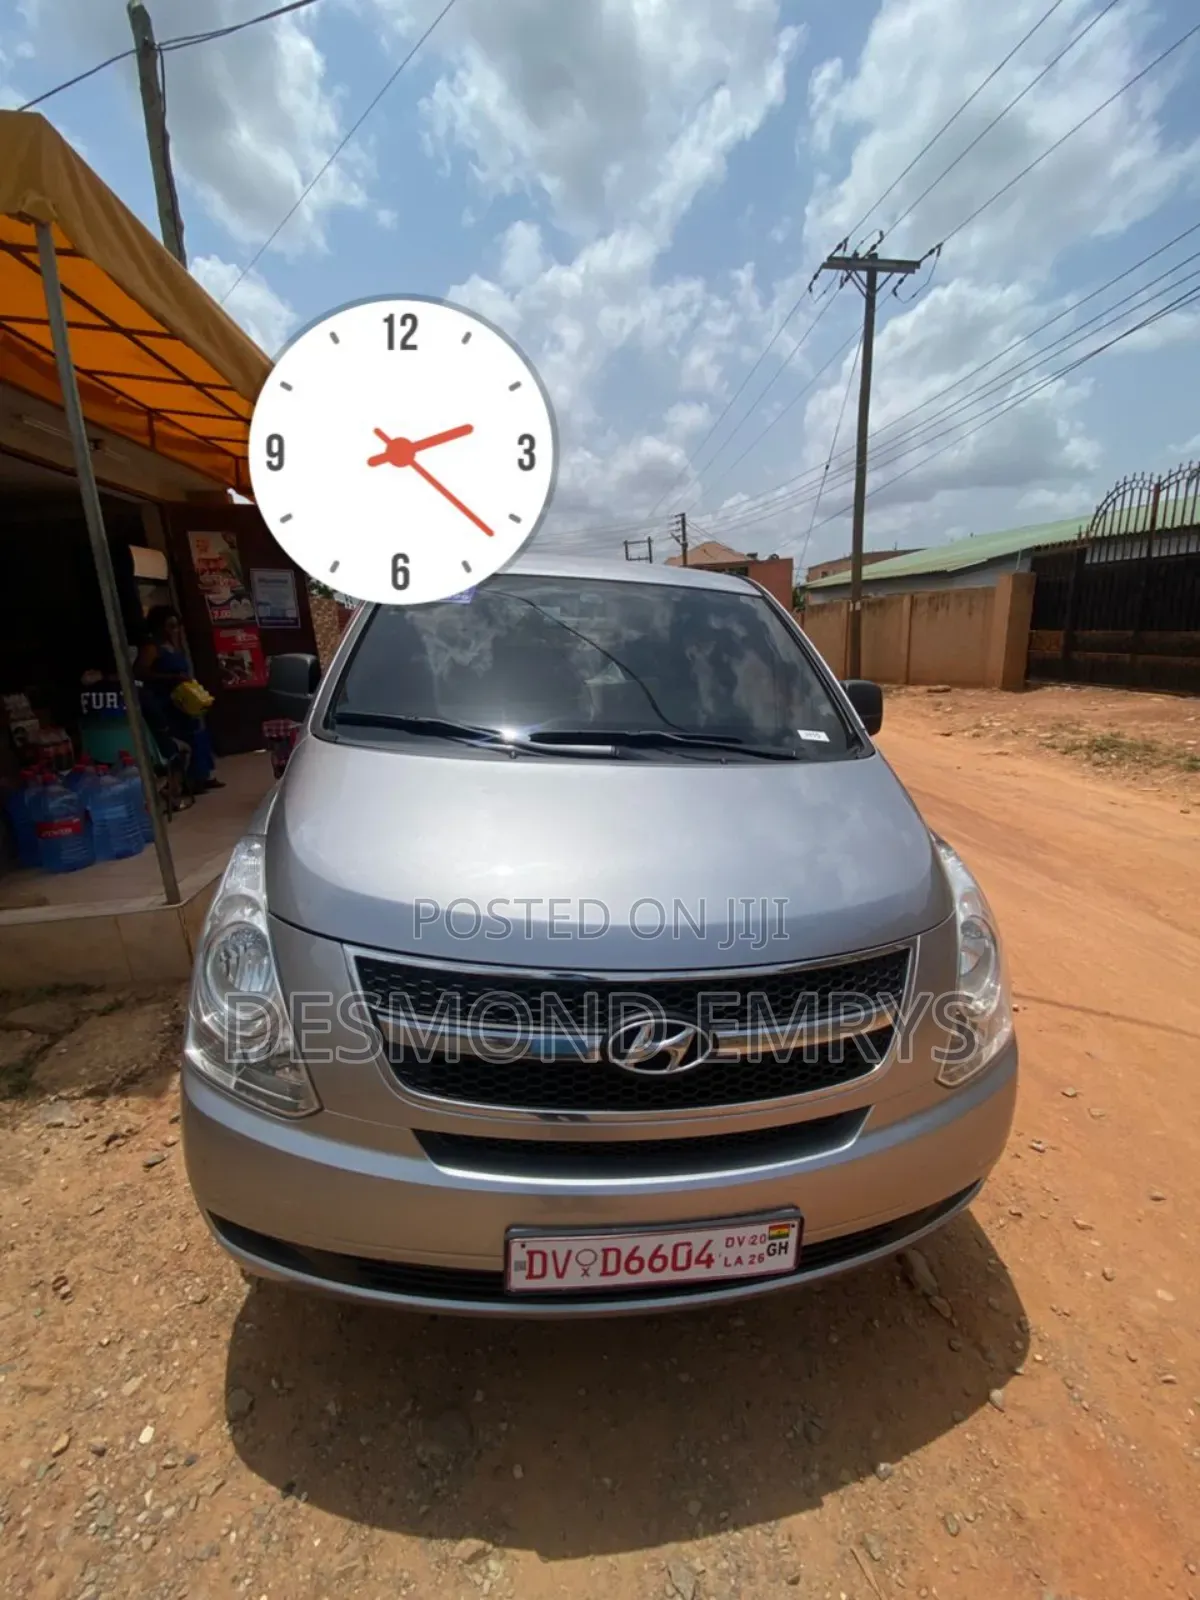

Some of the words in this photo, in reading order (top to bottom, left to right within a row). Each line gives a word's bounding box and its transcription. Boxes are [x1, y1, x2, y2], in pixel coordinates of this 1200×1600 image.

[80, 691, 126, 714] FUR
[725, 1236, 745, 1248] DV
[749, 1233, 767, 1245] 20
[766, 1241, 789, 1256] GH
[525, 1249, 573, 1280] DV
[599, 1239, 715, 1277] D6604
[723, 1256, 743, 1267] LA
